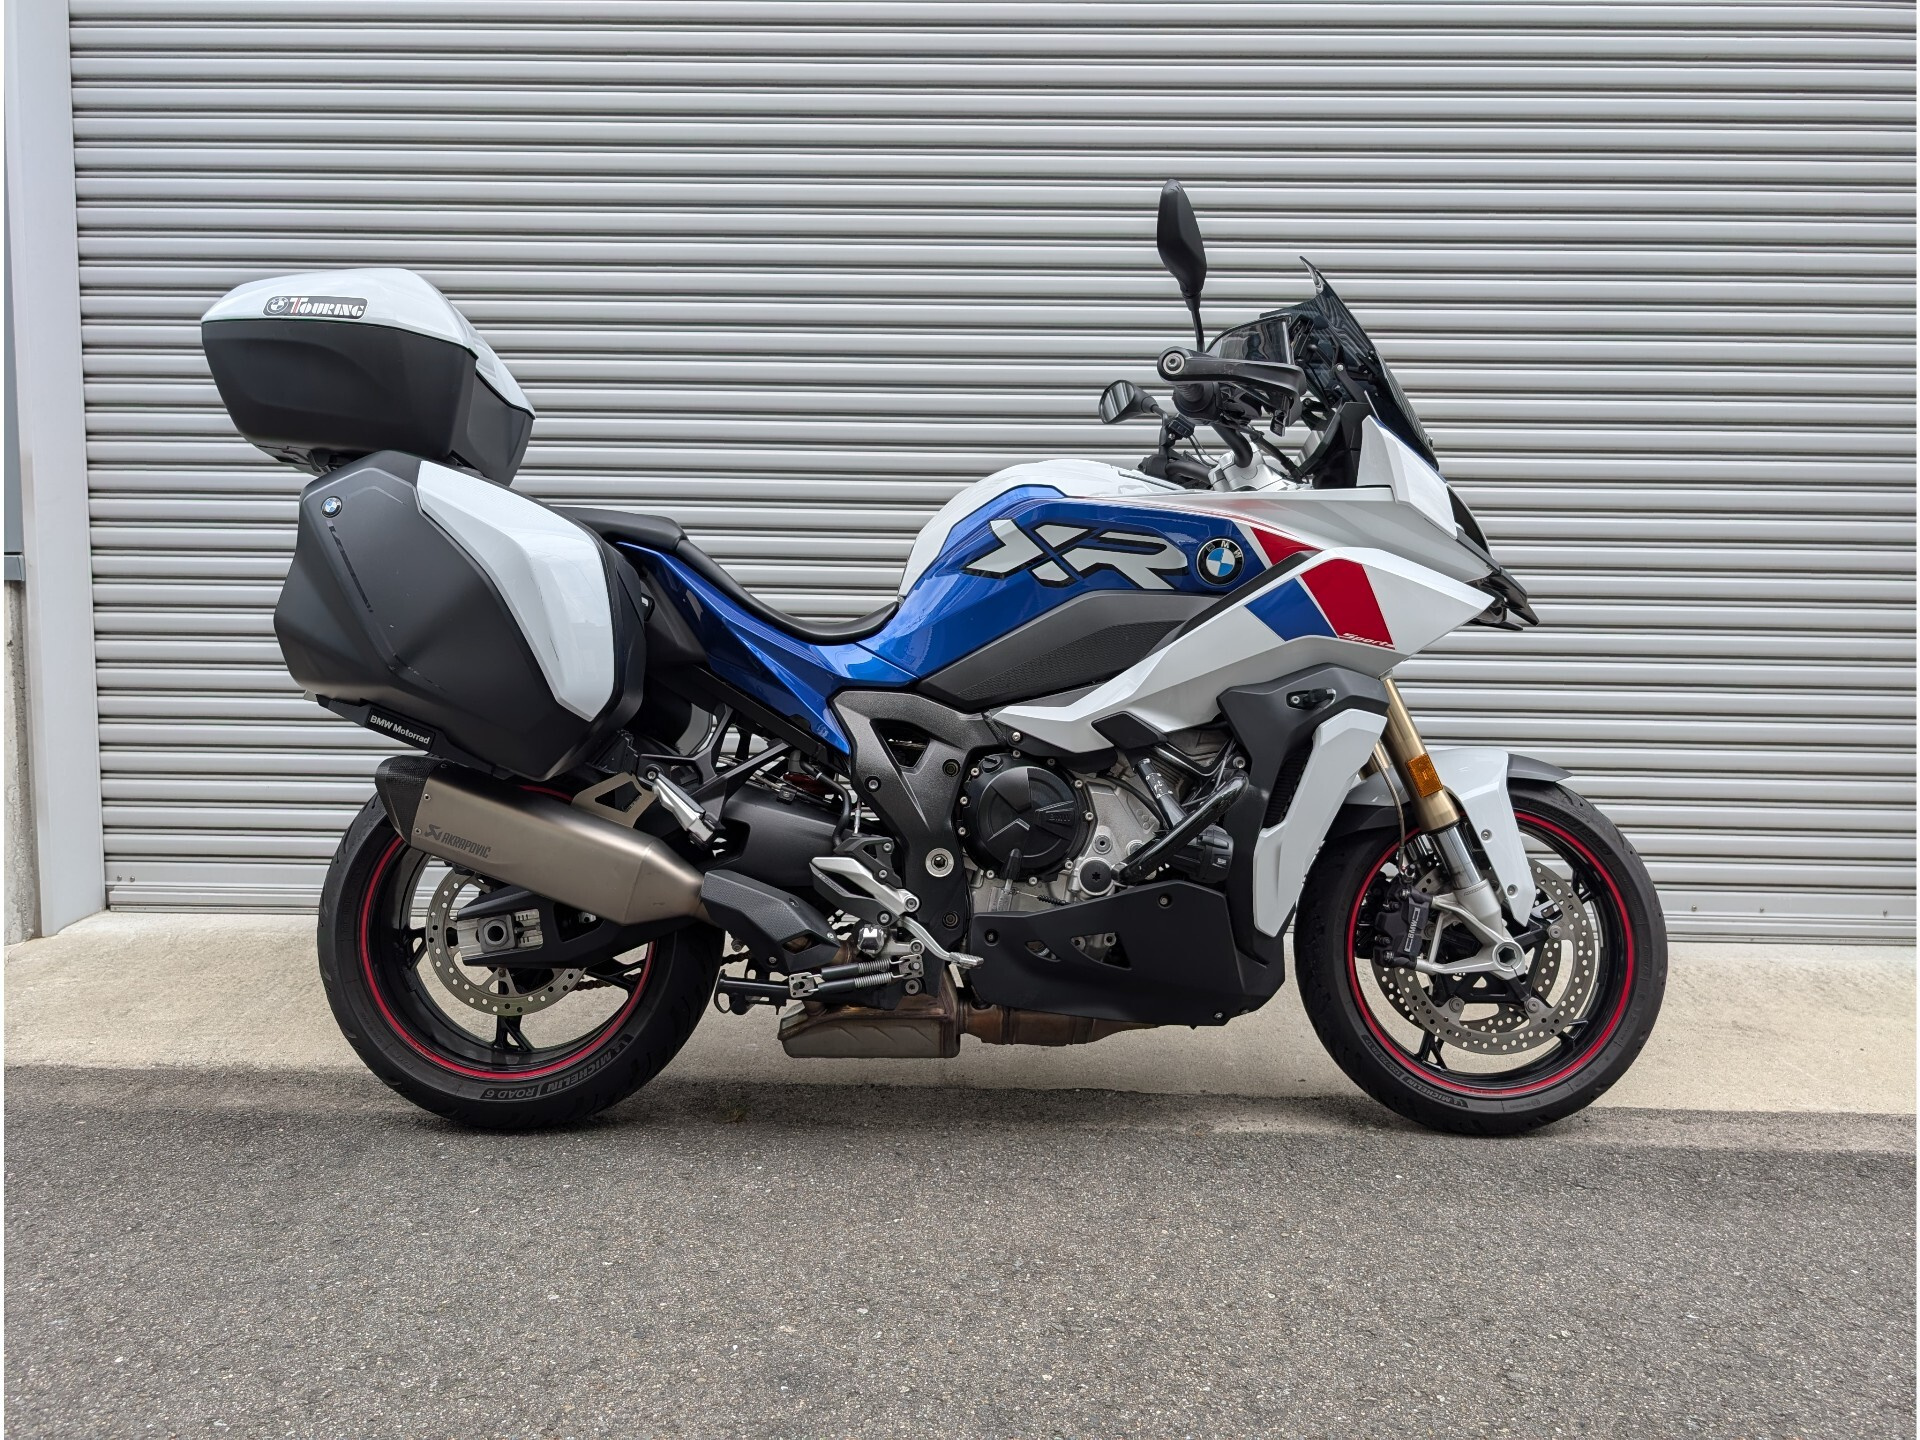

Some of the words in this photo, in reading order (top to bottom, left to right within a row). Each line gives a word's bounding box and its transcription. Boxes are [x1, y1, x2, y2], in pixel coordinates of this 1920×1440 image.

[961, 518, 1189, 590] XR
[370, 715, 393, 730] BMW
[392, 724, 431, 745] Motorrad
[1408, 919, 1418, 939] BMW
[547, 1051, 611, 1092] MICHELIN
[498, 1086, 535, 1099] ROAD
[1406, 1078, 1451, 1103] MICHELIN
